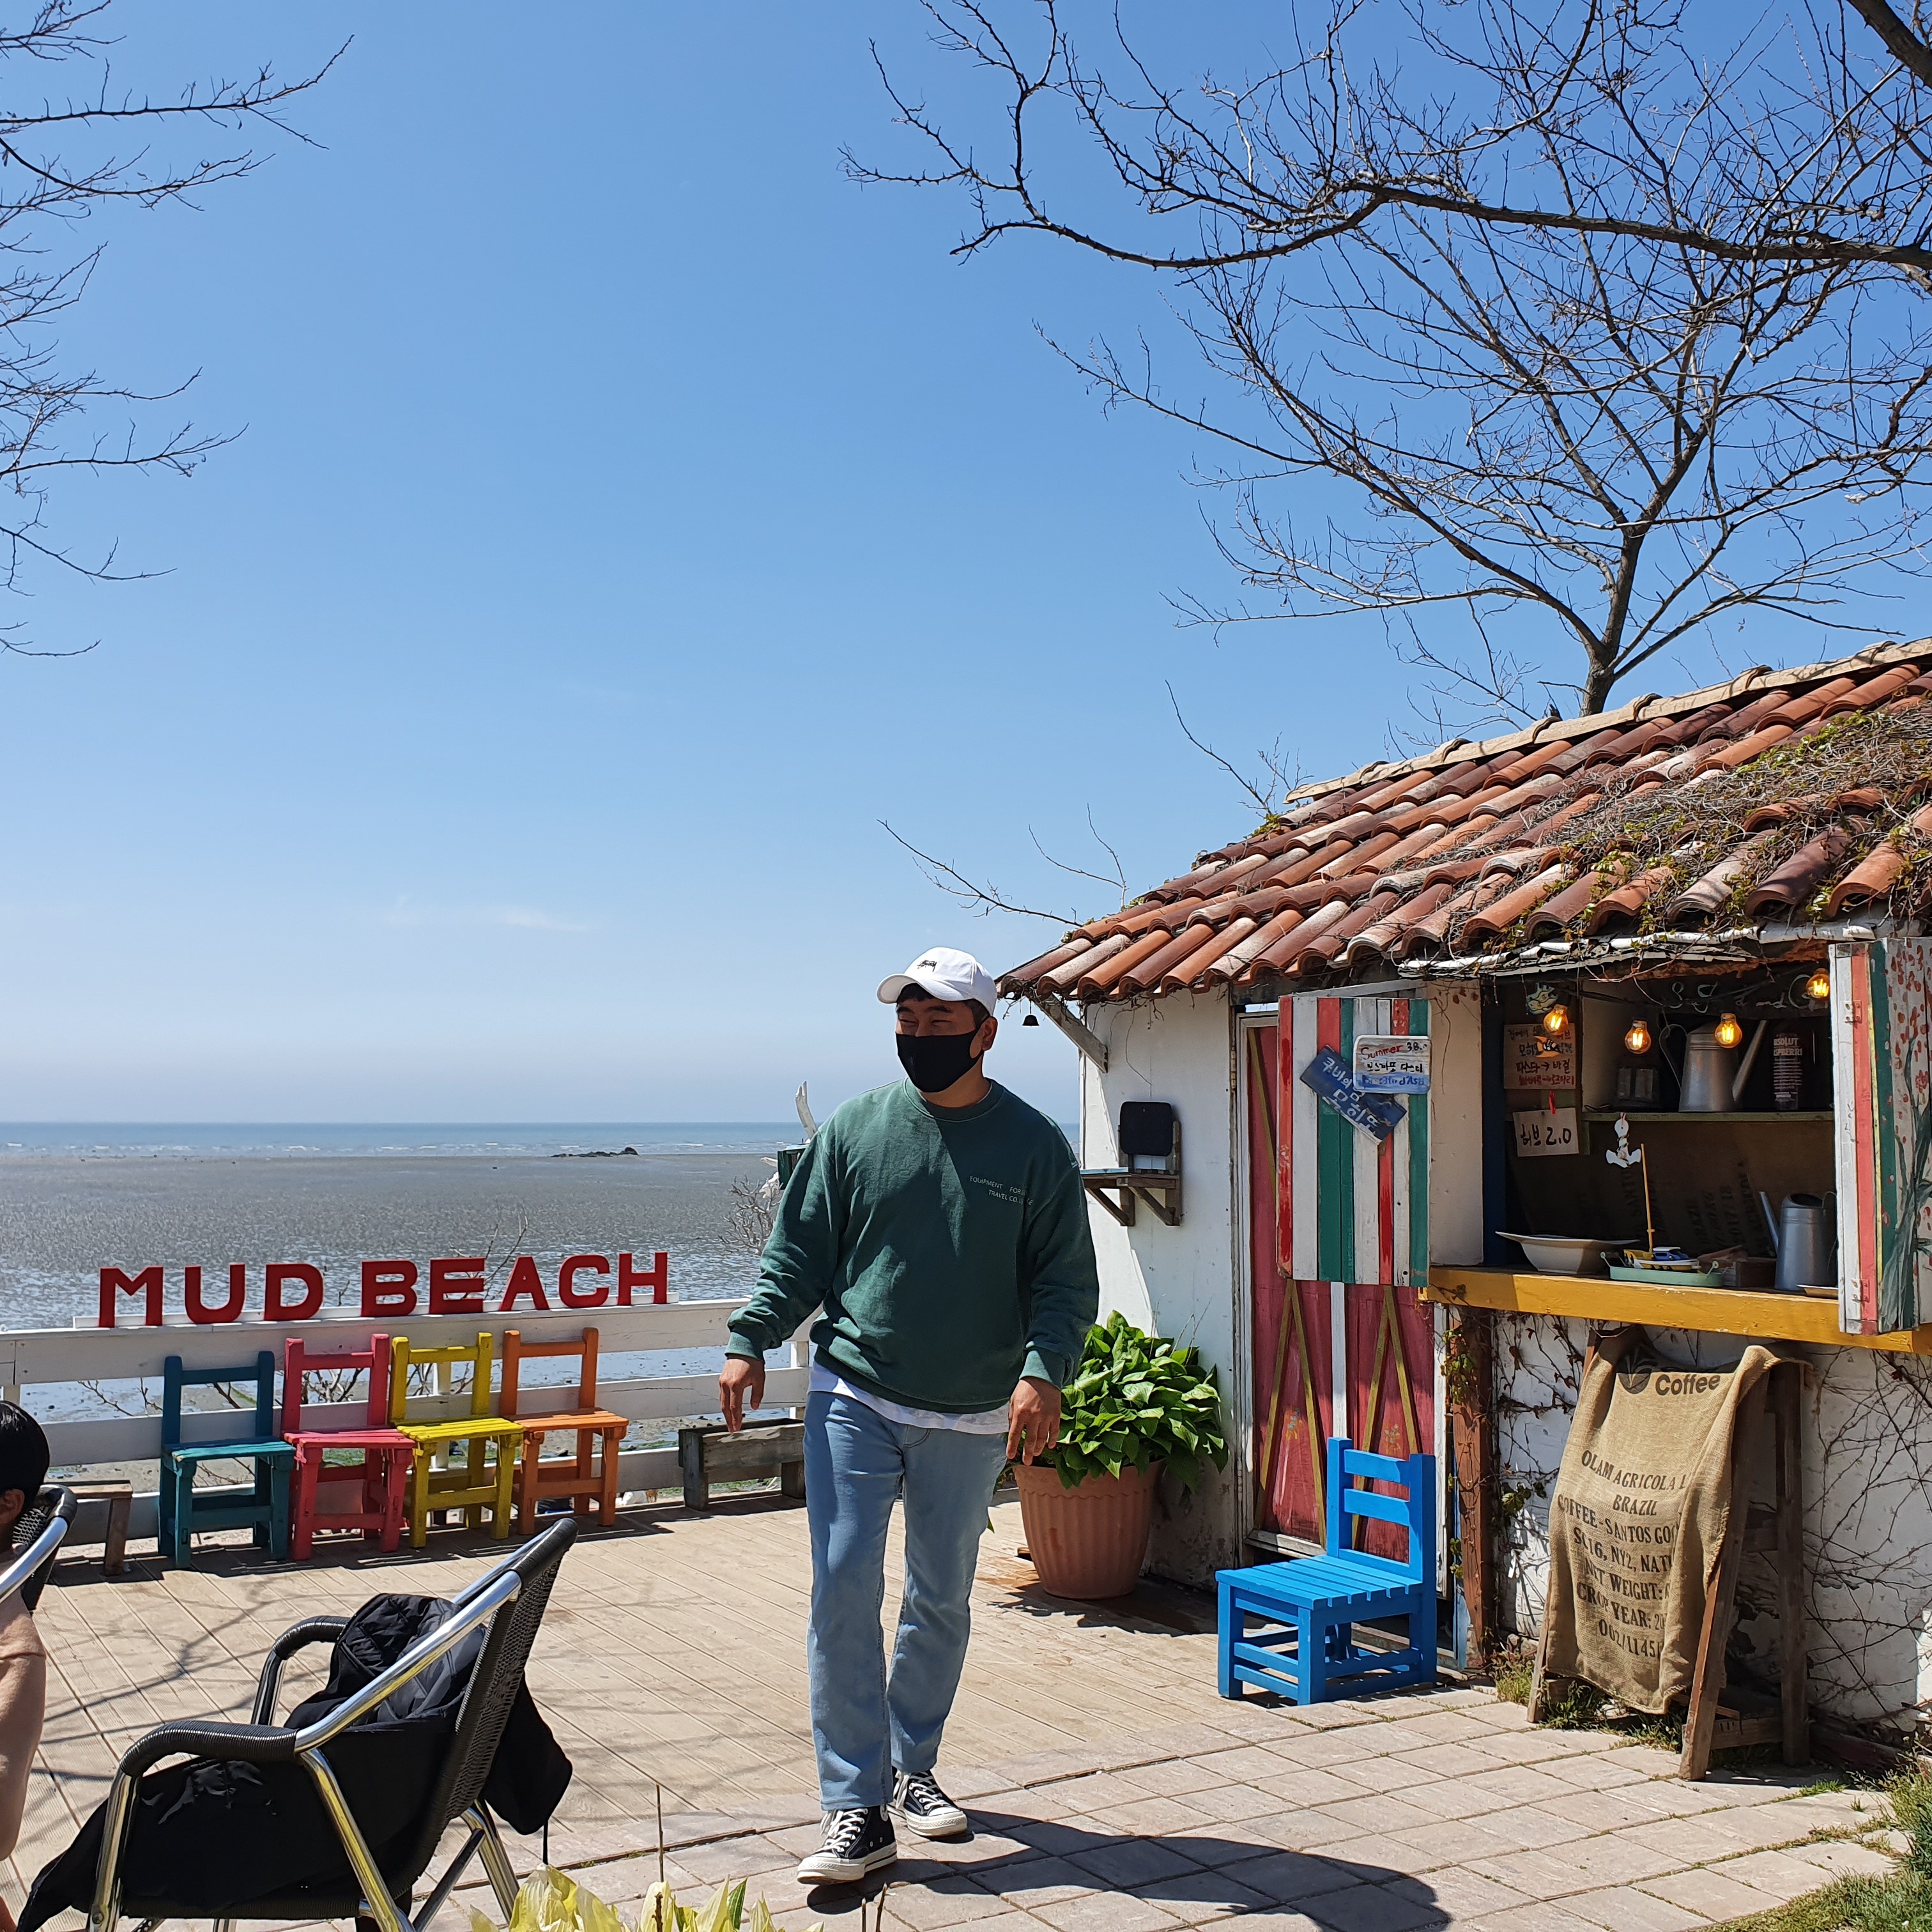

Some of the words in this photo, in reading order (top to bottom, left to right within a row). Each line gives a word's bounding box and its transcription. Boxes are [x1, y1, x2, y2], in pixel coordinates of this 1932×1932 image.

[1360, 1044, 1404, 1060] Summer
[1322, 1057, 1353, 1089] 쿠바의
[1520, 1123, 1541, 1147] 허브
[1545, 1126, 1572, 1146] 2.0
[969, 1176, 1004, 1189] EQUIPMENT
[988, 1189, 1008, 1200] TRAVEL
[99, 1262, 324, 1328] MUD
[360, 1251, 668, 1318] BEACH
[1655, 1374, 1721, 1396] Coffee
[1581, 1449, 1614, 1481] OLAM
[1613, 1469, 1676, 1491] AGRICOLA
[1613, 1494, 1658, 1516] BRAZIL
[1576, 1582, 1608, 1612] CROP
[1609, 1572, 1663, 1600] WEIGHT:
